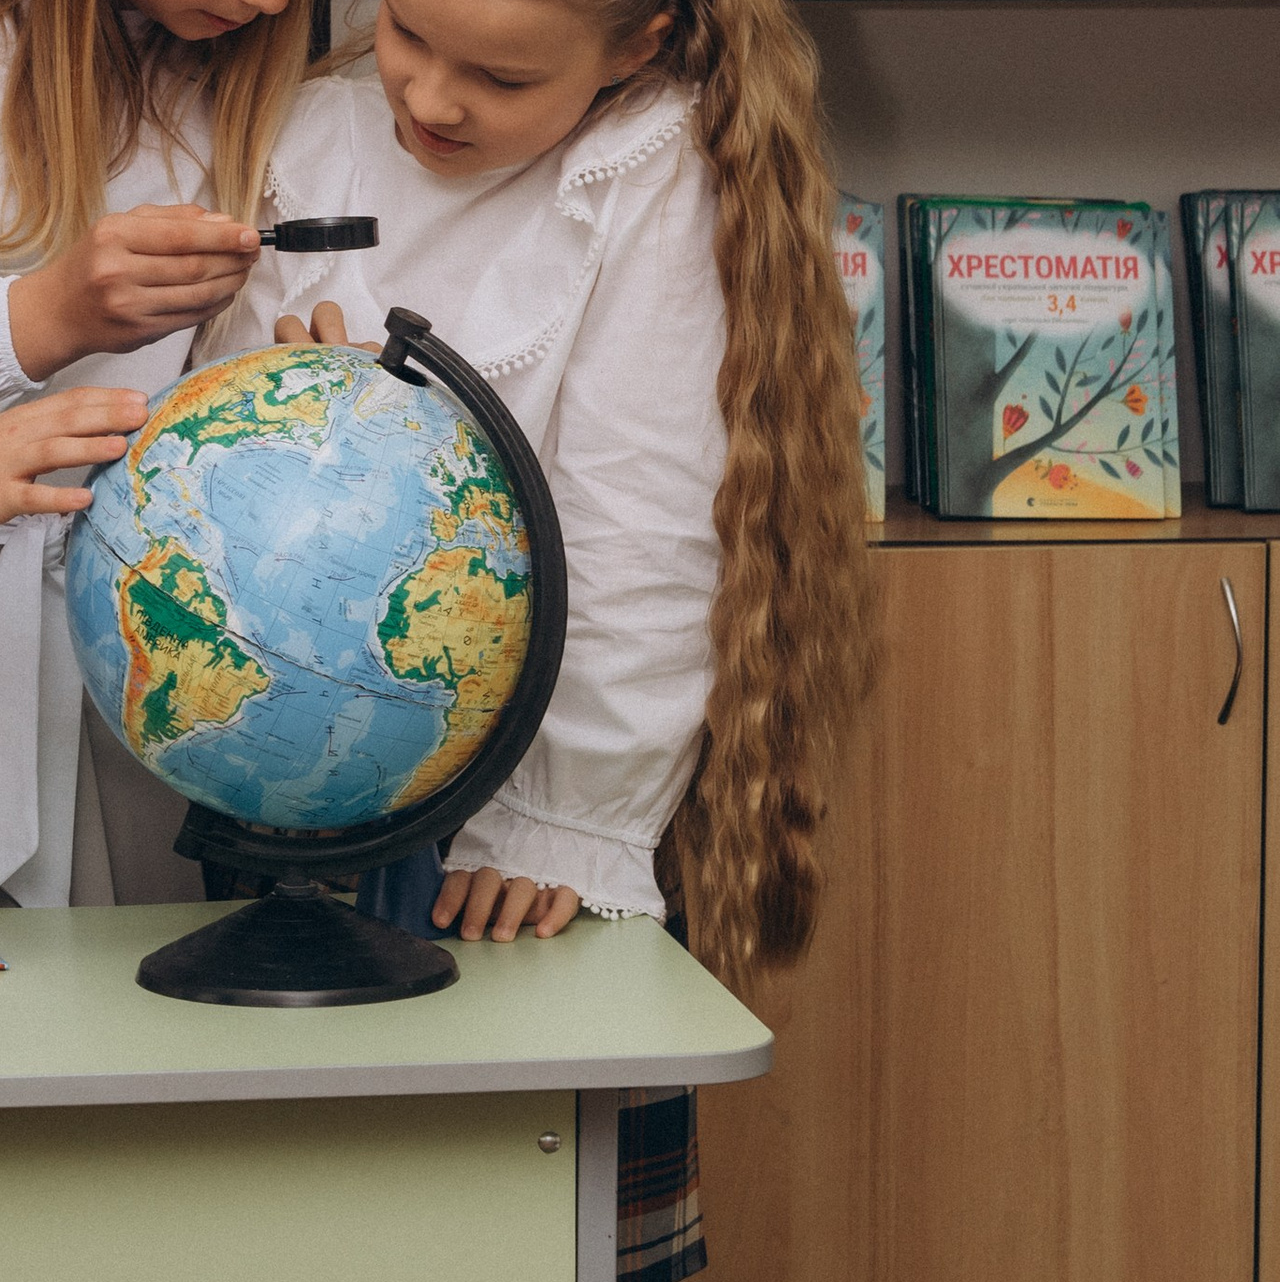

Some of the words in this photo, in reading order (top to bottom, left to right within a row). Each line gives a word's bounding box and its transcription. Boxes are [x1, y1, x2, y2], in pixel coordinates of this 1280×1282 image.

[948, 254, 1139, 279] ХРЕСТОМАТІЯ
[1251, 250, 1280, 274] ХР
[135, 625, 180, 661] АМЕРИКА
